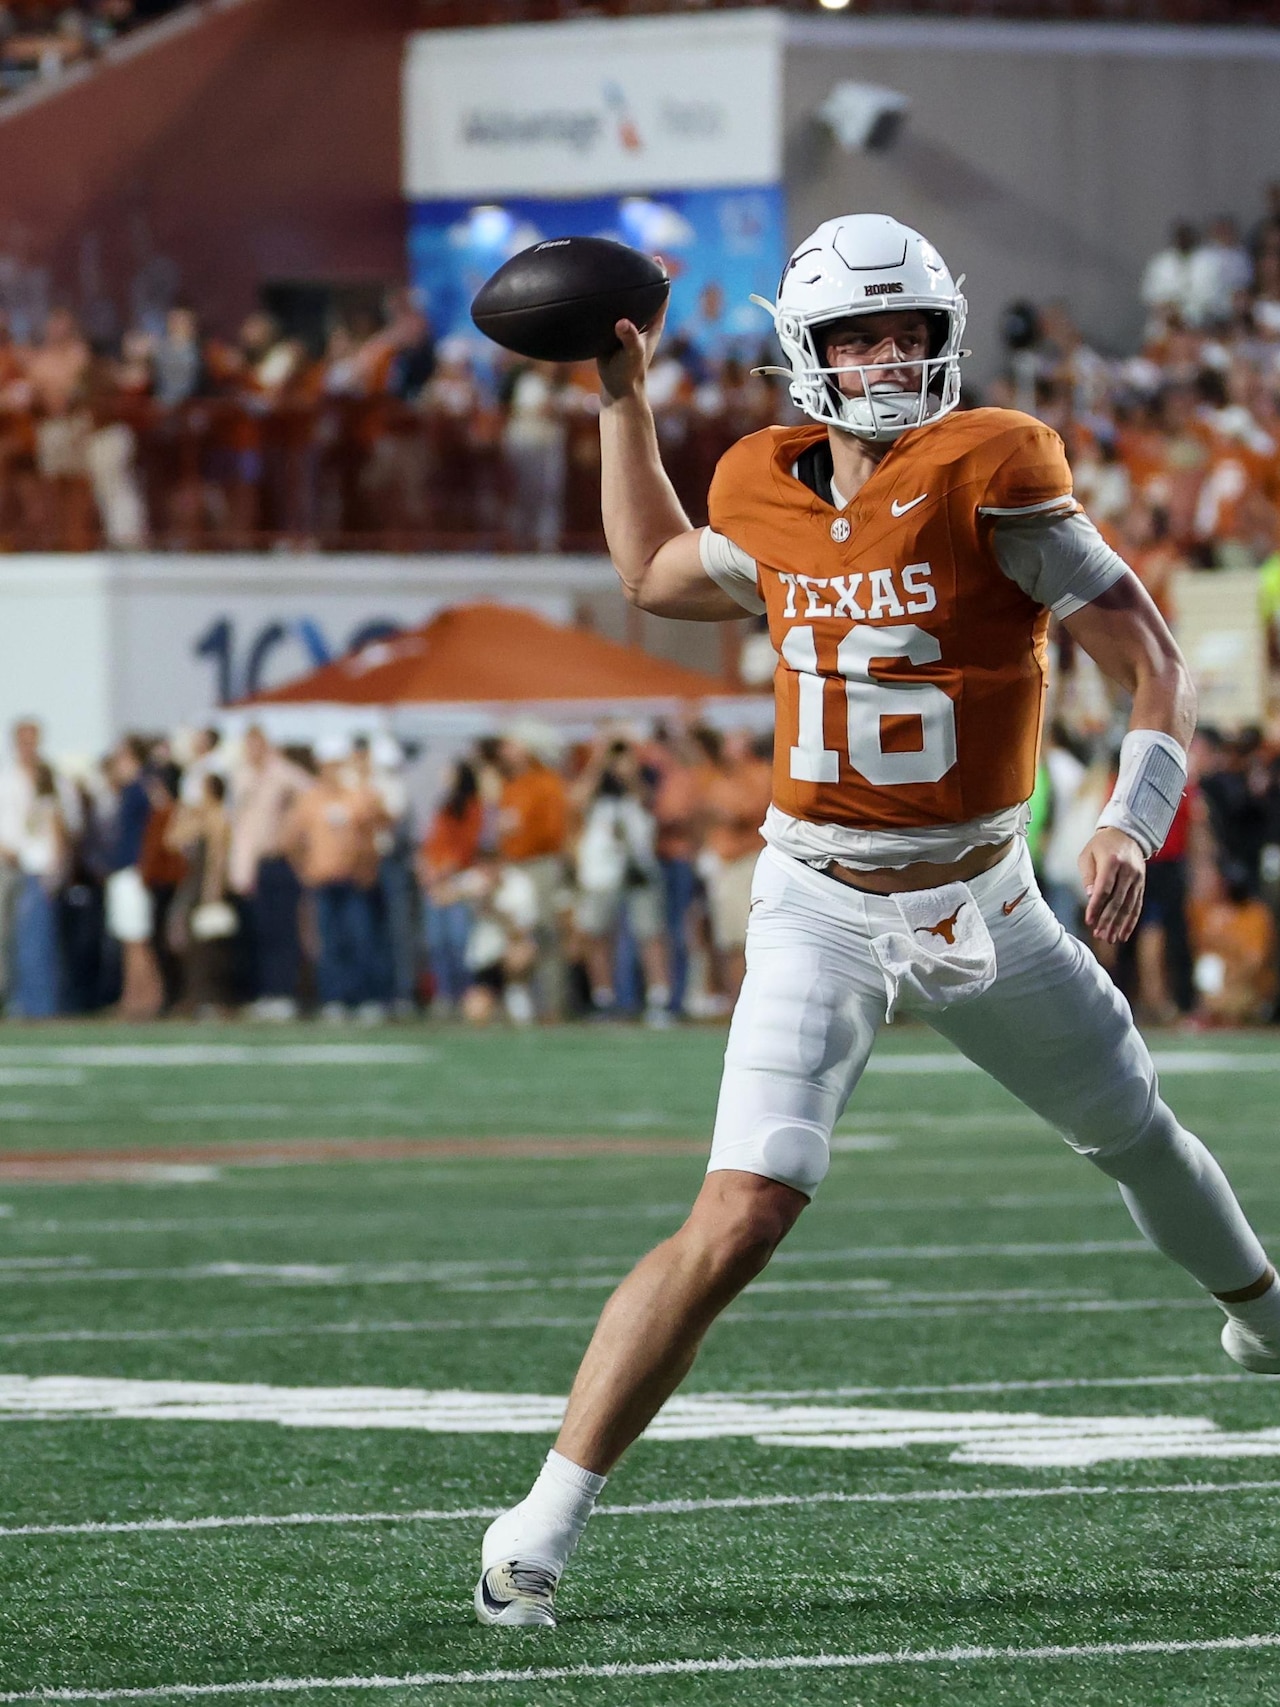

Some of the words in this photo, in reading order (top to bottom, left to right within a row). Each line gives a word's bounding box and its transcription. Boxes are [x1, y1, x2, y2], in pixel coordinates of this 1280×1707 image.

[864, 282, 904, 296] HORNS
[831, 518, 850, 542] SEC
[778, 561, 938, 621] TEXAS
[780, 623, 958, 787] 16
